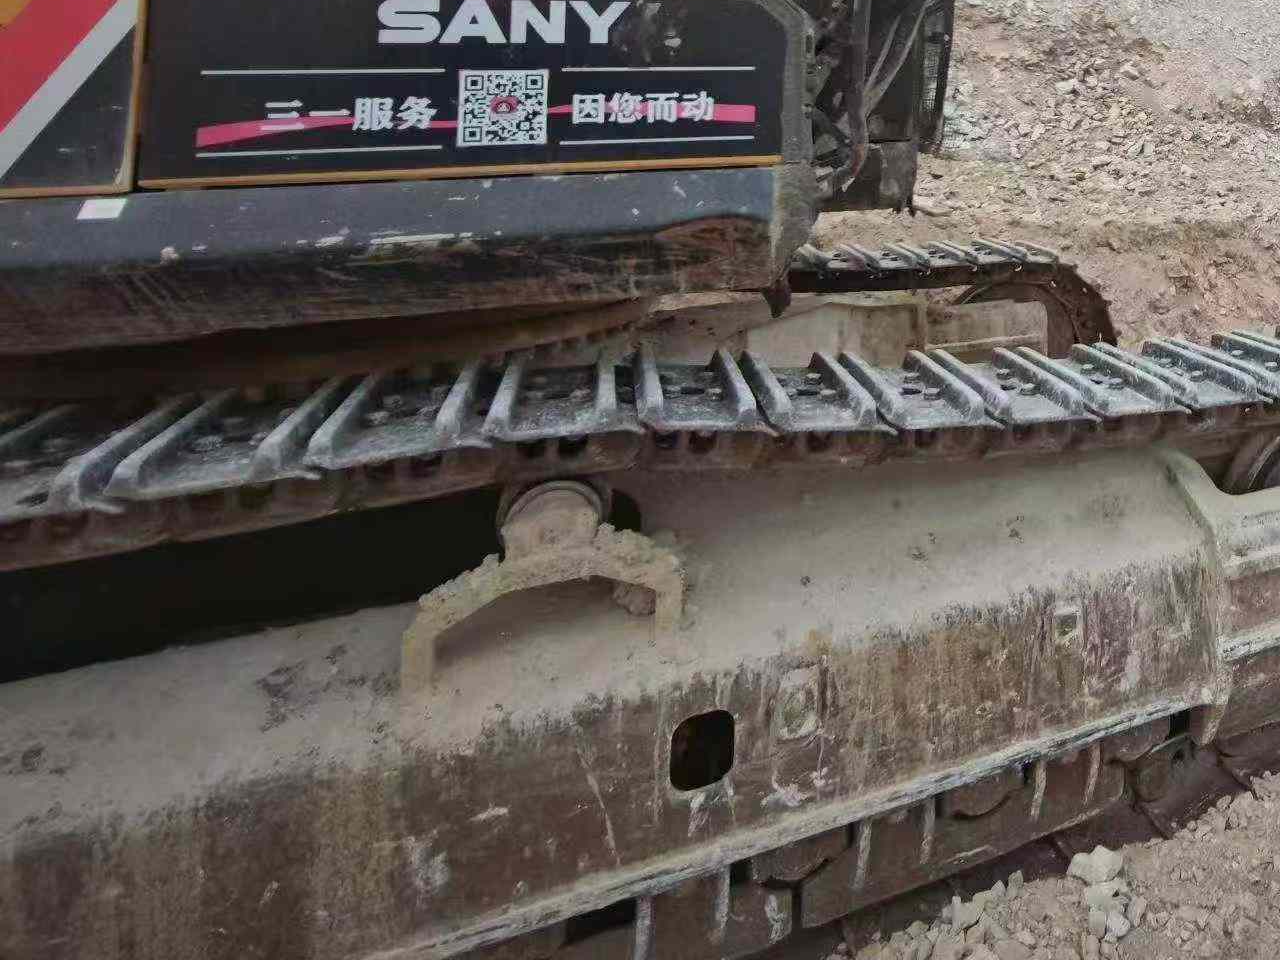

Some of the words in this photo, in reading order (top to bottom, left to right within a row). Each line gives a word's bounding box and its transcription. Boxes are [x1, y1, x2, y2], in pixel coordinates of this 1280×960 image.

[260, 96, 437, 131] 三一服务
[572, 91, 714, 123] 因您而动
